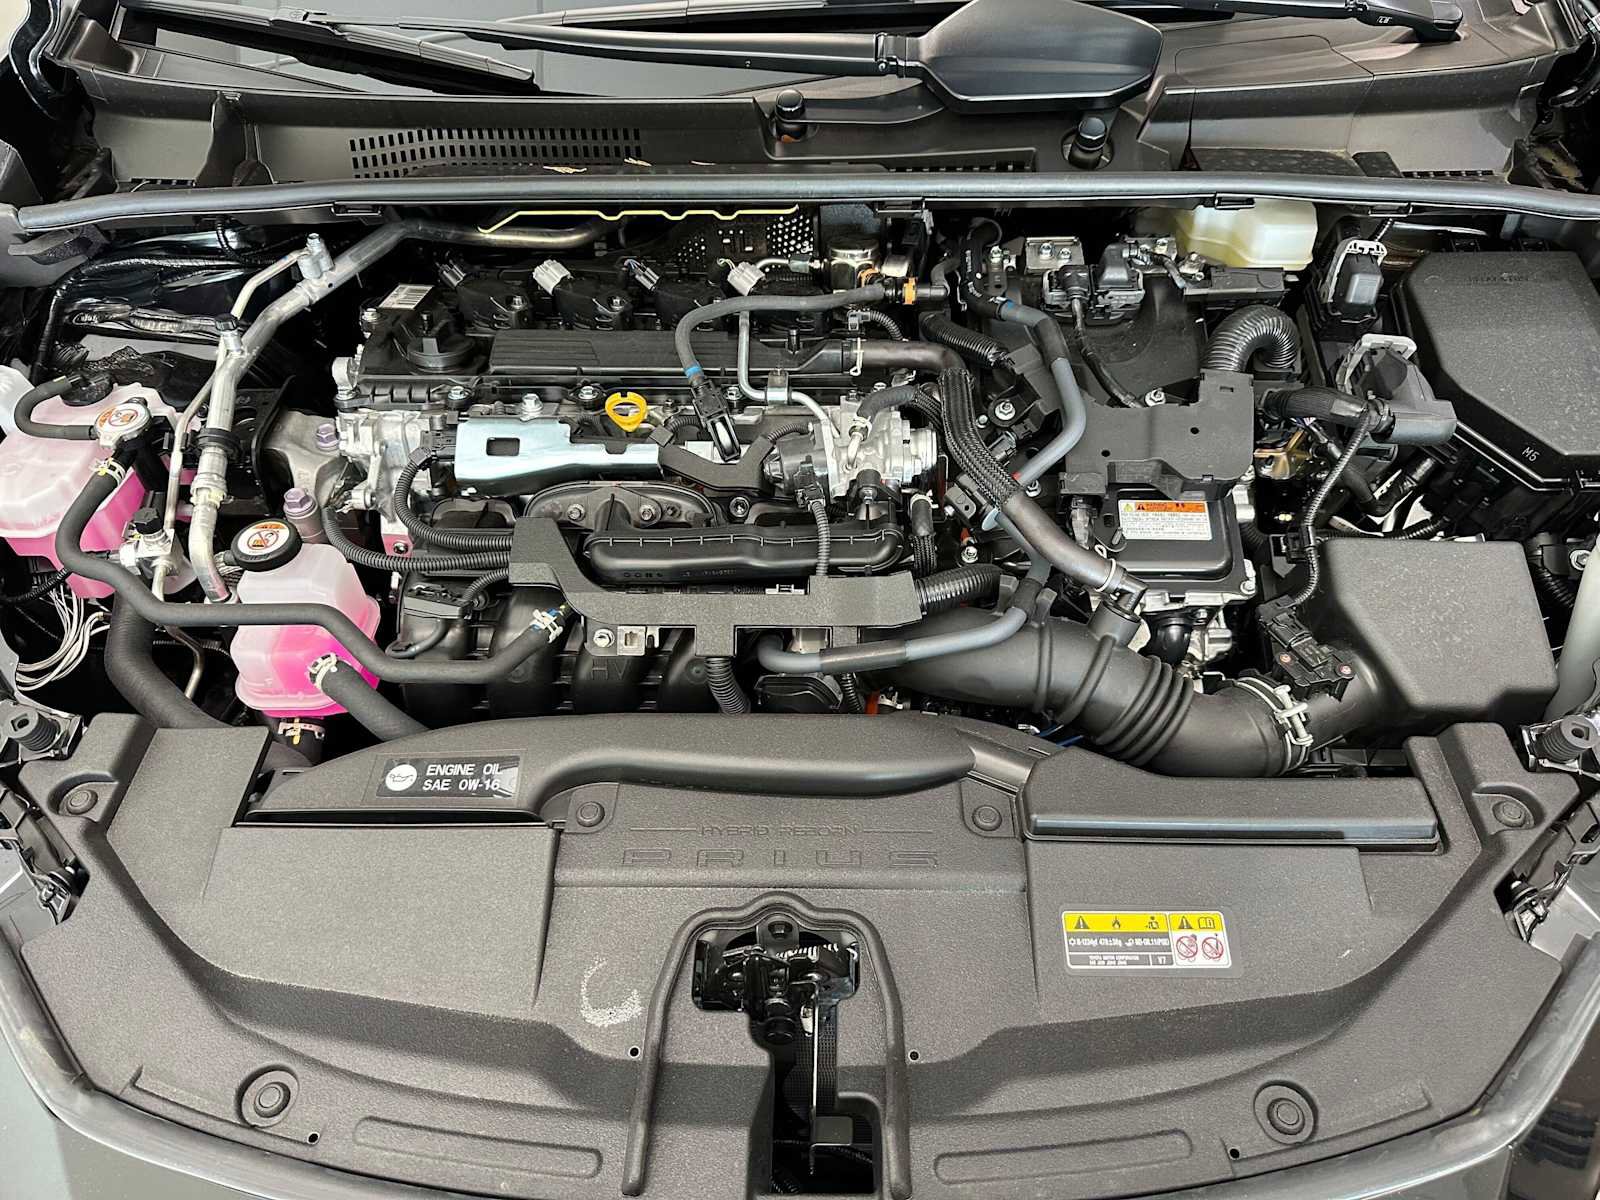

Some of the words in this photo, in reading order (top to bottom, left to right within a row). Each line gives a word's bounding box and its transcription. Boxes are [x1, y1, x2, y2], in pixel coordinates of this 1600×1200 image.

[1521, 446, 1541, 462] M5
[426, 763, 476, 776] ENGINE
[482, 763, 504, 775] OIL
[422, 779, 452, 790] SAE
[458, 779, 500, 790] 0W-16
[699, 824, 769, 836] HYBRID
[780, 825, 858, 837] REBORN
[622, 848, 939, 868] PRIUS
